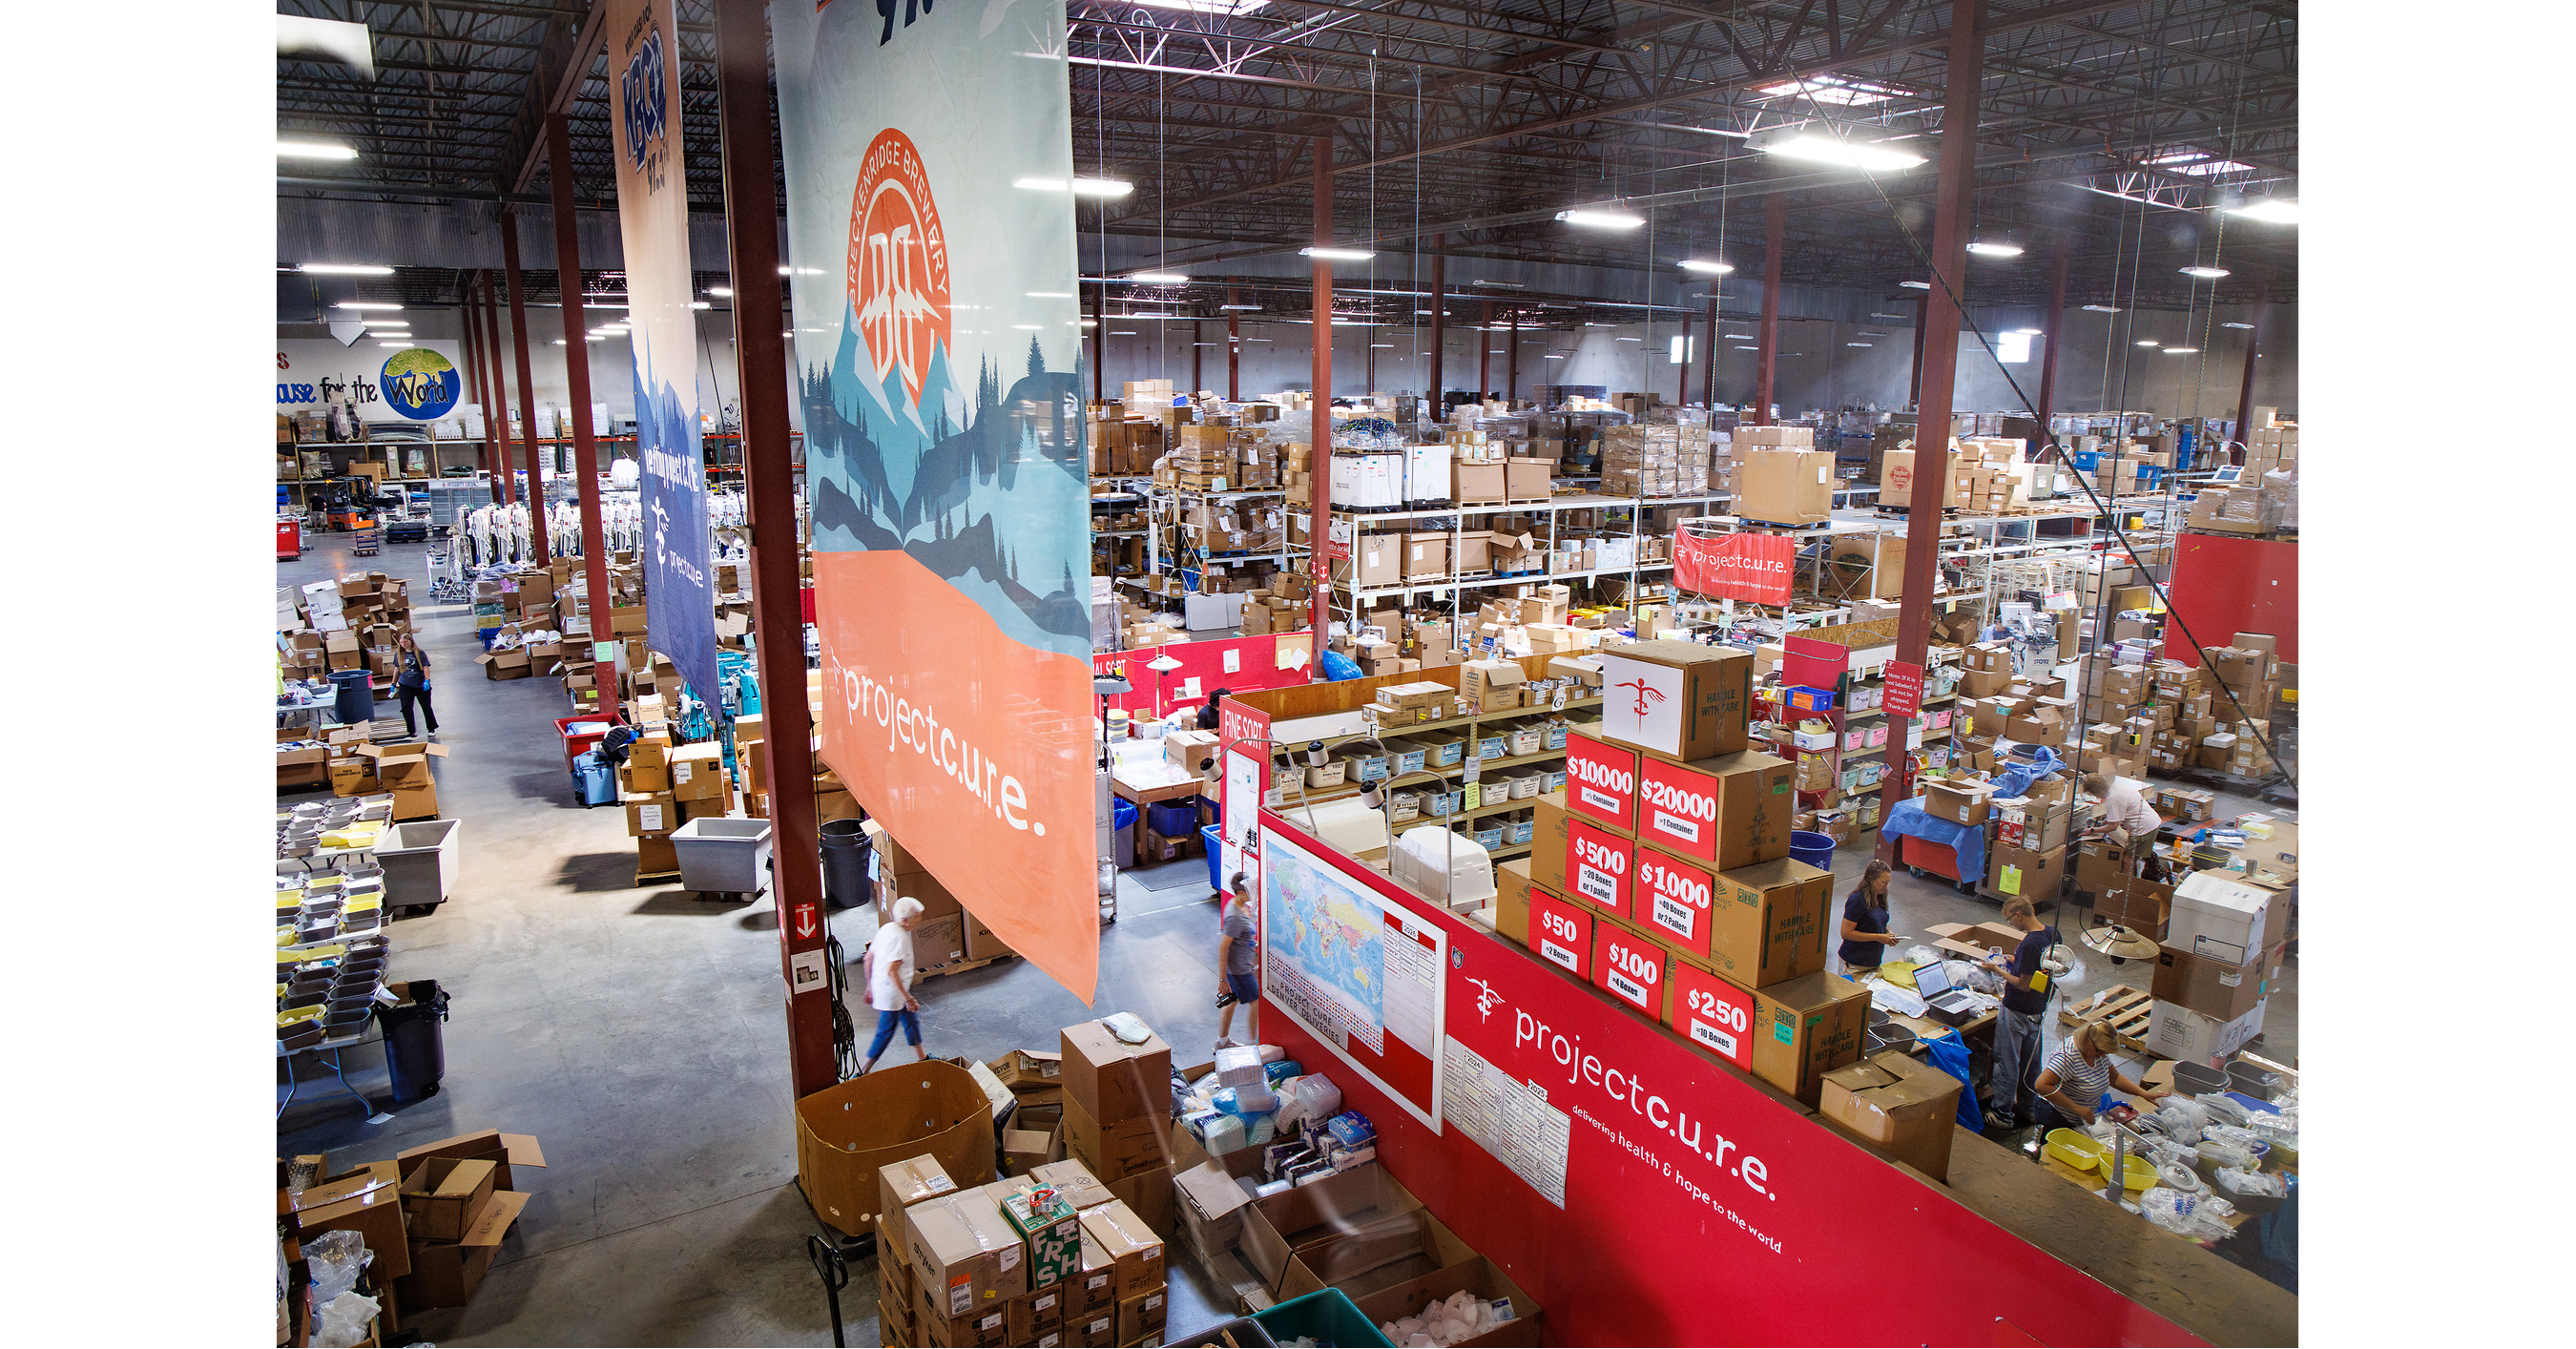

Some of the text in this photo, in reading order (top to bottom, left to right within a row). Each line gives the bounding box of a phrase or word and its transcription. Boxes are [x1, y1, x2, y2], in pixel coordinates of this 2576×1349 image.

[849, 140, 947, 306] BRECKENRIDGE BREWERY
[351, 375, 378, 404] the
[384, 374, 449, 405] World
[1693, 550, 1787, 574] projectc.u.r.e.
[1750, 581, 1761, 590] hope
[1934, 653, 1941, 666] 5
[1887, 702, 1901, 711] Thank
[1224, 710, 1263, 751] FINE SORT
[844, 670, 1046, 837] projectc.u.r.e.
[1568, 756, 1633, 796] $10,000
[1592, 794, 1615, 809] Container
[1640, 778, 1716, 822] $20,000
[1666, 820, 1693, 836] Container
[1575, 836, 1626, 875] $500
[1584, 869, 1612, 888] =20 Boxes
[1593, 886, 1610, 901] pallet
[1640, 862, 1710, 909] $1,000
[1542, 909, 1577, 943] $50
[1657, 912, 1664, 921] or
[1668, 917, 1688, 934] Pallets
[1670, 903, 1687, 920] Boxes
[1546, 946, 1570, 964] =2 Boxes
[1609, 943, 1657, 985] $100
[1611, 977, 1638, 997] =4 Boxes
[1271, 984, 1340, 1044] DENVER DELIVERIES
[1280, 982, 1333, 1027] PROJECT CURE
[1688, 987, 1747, 1033] $250
[1695, 1027, 1730, 1049] =10 Boxes
[1467, 1054, 1481, 1069] 2024
[1515, 1007, 1776, 1201] projectc.u.r.e.
[1529, 1082, 1546, 1098] 2025
[1572, 1105, 1782, 1255] delivering health & hope to the world
[913, 1241, 936, 1278] stryker
